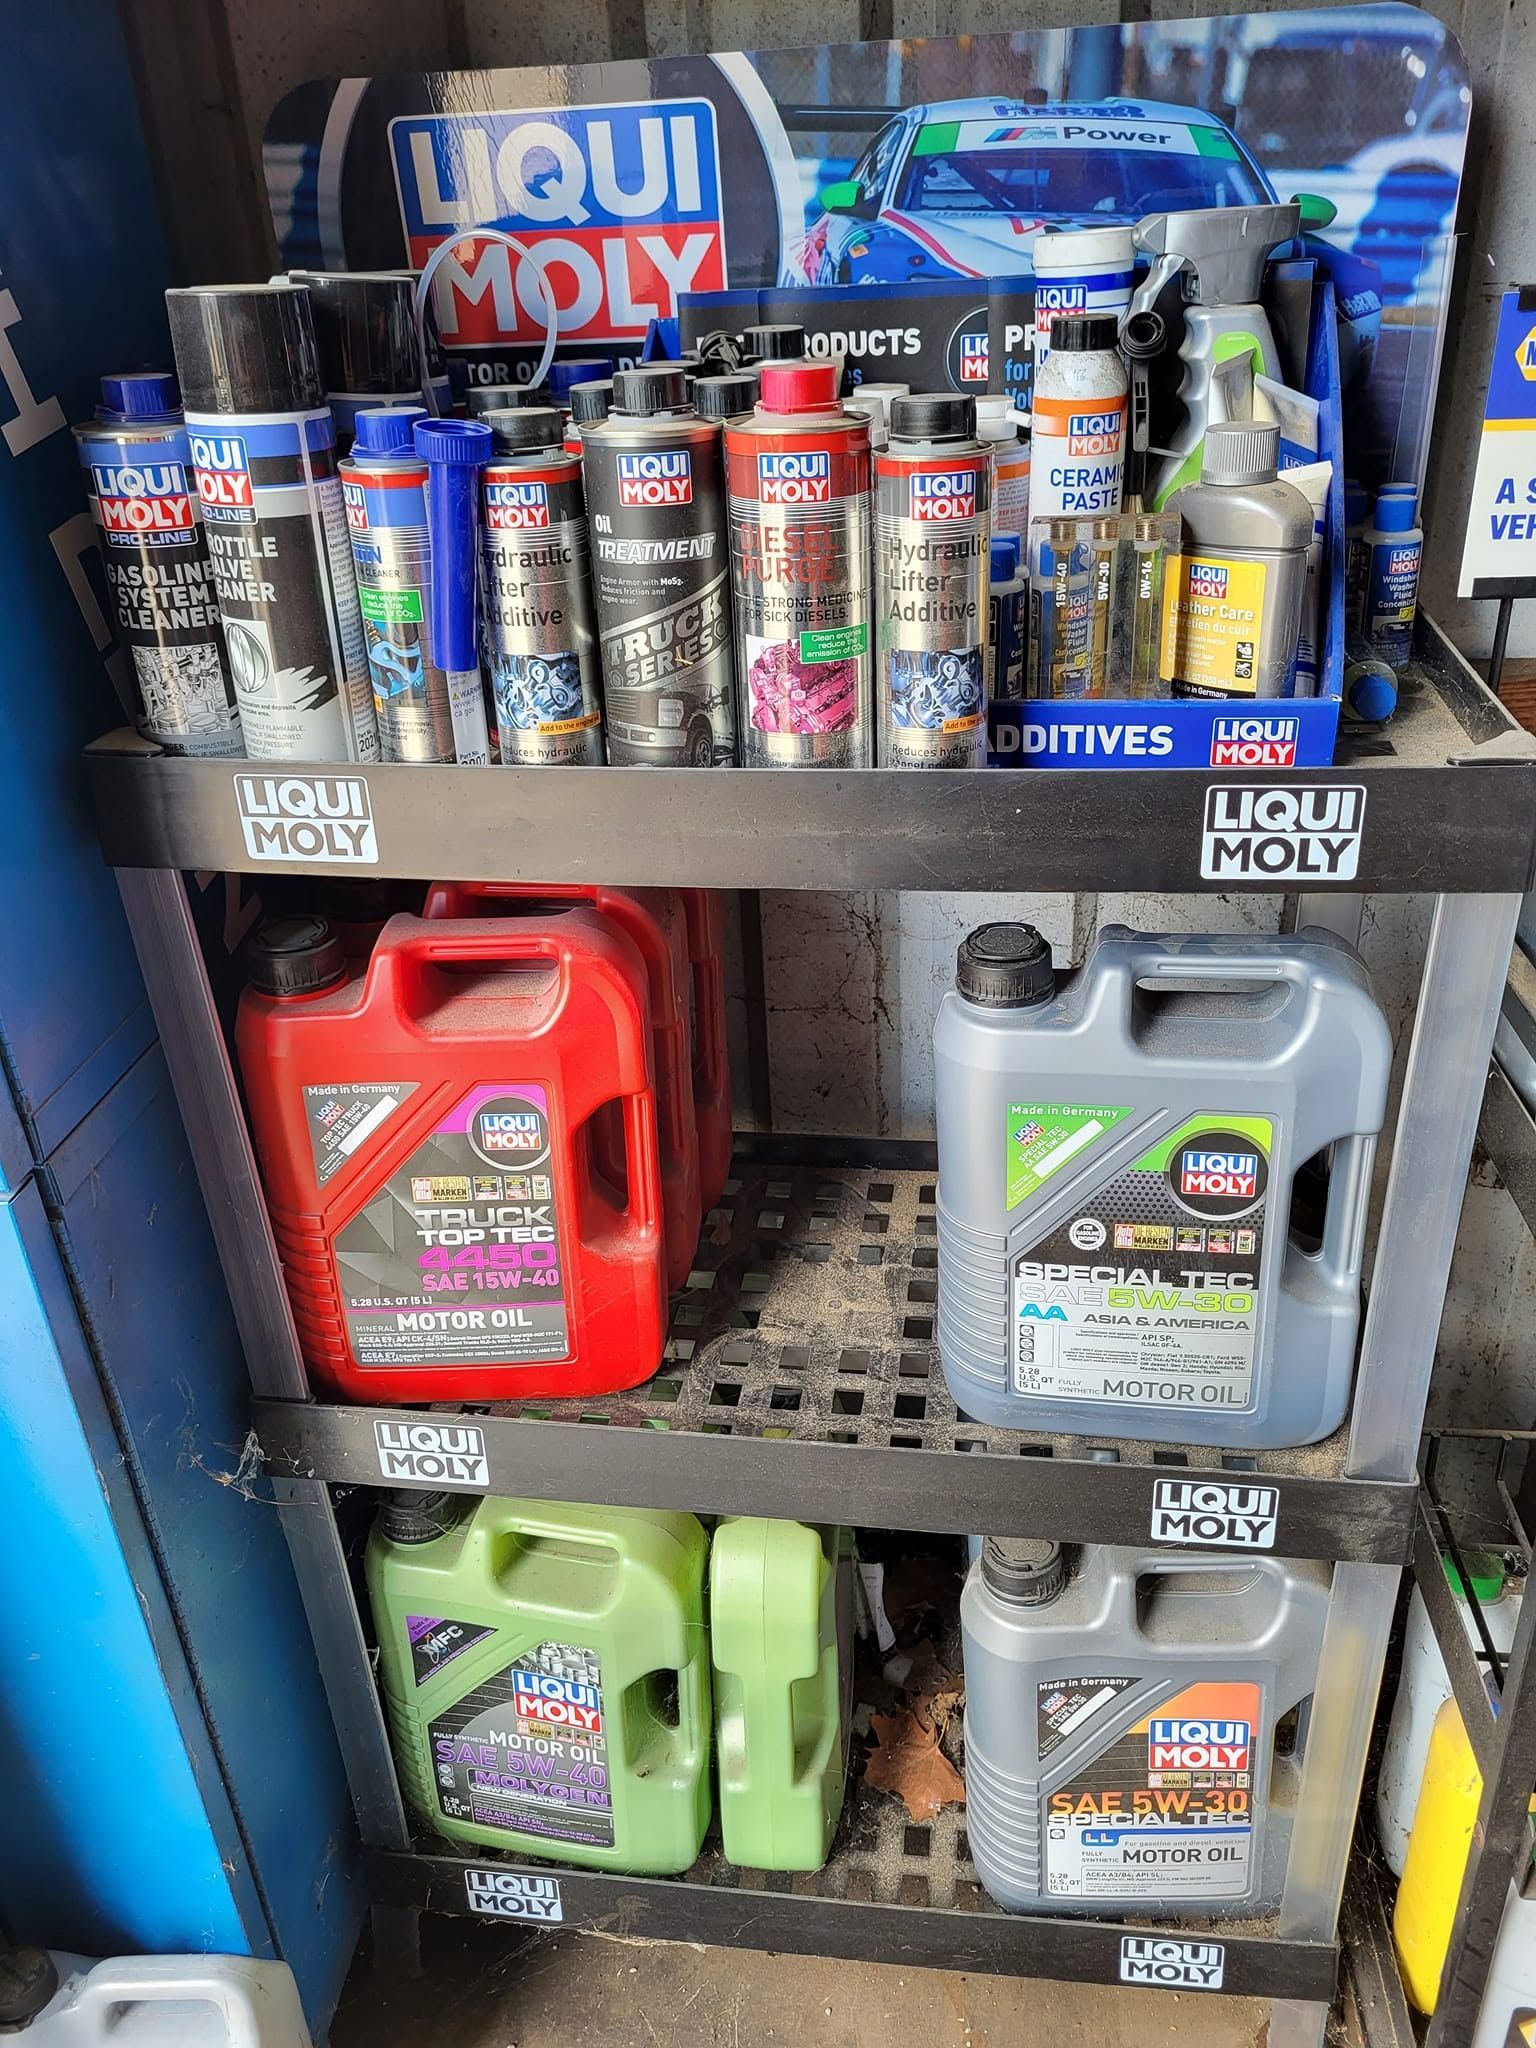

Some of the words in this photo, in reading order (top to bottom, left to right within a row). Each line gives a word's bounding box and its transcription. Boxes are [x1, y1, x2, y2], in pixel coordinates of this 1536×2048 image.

[1063, 127, 1171, 144] Power
[408, 114, 701, 227] LIQUI
[427, 232, 714, 335] MOLY
[1037, 287, 1084, 310] LIQUI
[1004, 358, 1032, 382] for
[1071, 414, 1120, 436] LIQUI
[1070, 436, 1119, 456] MOLY
[620, 454, 688, 480] LIQUI
[761, 455, 827, 479] LIQUI
[94, 467, 182, 498] LIQUI
[198, 473, 248, 504] OLY
[621, 479, 690, 504] MOLY
[762, 478, 828, 503] MOLY
[913, 474, 973, 496] LIQUI
[1495, 478, 1515, 504] A
[486, 486, 543, 507] LIQUI
[914, 496, 974, 519] MOLY
[1062, 488, 1119, 511] PASTE
[102, 499, 195, 529] MOLY
[488, 507, 546, 528] MOLY
[595, 514, 612, 534] Oil
[109, 531, 193, 545] PRO-LINE
[597, 535, 715, 561] TREATMENT
[740, 523, 841, 554] DIESEL
[890, 534, 987, 567] Hydraulic
[107, 560, 213, 586] GASOLINE
[742, 554, 836, 584] PURGE
[1190, 565, 1226, 583] LIQUI
[1391, 559, 1419, 574] MOLY
[618, 577, 641, 586] Armor
[641, 577, 659, 586] with
[890, 568, 952, 592] Lifter
[1055, 562, 1068, 608] 15W-40
[1098, 561, 1110, 601] 5W-30
[1140, 560, 1153, 599] 0W-16
[1189, 581, 1227, 599] MOLY
[1389, 581, 1416, 593] Washer
[117, 587, 209, 609] SYSTEM
[763, 597, 812, 609] STRONG
[817, 587, 867, 607] MEDICINE
[1393, 590, 1412, 600] Fluid
[119, 607, 221, 631] CLEANER
[764, 610, 792, 622] SICK
[795, 607, 849, 623] DIESELS.
[890, 600, 977, 623] Additive
[1170, 600, 1217, 617] Leather
[1219, 604, 1254, 622] Care
[607, 588, 723, 667] TRUCK
[811, 634, 835, 642] Clean
[836, 627, 862, 641] engines
[1212, 622, 1226, 633] du
[1228, 624, 1251, 636] cuir
[626, 627, 713, 687] SERIES
[1215, 720, 1294, 743] LIQUI
[892, 743, 937, 758] Reduces
[939, 739, 984, 758] hydraulic
[1214, 743, 1294, 766] MOLY
[242, 779, 364, 818] LIQUI
[1213, 791, 1354, 833] LIQUI
[251, 821, 369, 857] MOLY
[1211, 837, 1355, 875] MOLY
[308, 1087, 338, 1096] Made
[339, 1085, 350, 1094] in
[351, 1084, 401, 1095] Germany
[484, 1115, 537, 1133] LIQUI
[1011, 1106, 1043, 1115] Made
[1048, 1106, 1058, 1115] in
[1062, 1106, 1118, 1119] Germany
[485, 1132, 539, 1149] MOLY
[1018, 1138, 1049, 1163] SPECIAL
[1046, 1125, 1062, 1140] TEC
[1020, 1126, 1044, 1147] MOLY
[1186, 1153, 1254, 1175] LIQUI
[433, 1189, 467, 1197] MARKEN
[1185, 1174, 1255, 1197] MOLY
[414, 1206, 553, 1229] TRUCK
[416, 1228, 486, 1246] TOP
[490, 1225, 555, 1244] TEC
[1135, 1237, 1169, 1246] MARKEN
[418, 1243, 557, 1272] 4450
[422, 1273, 469, 1292] SAE
[473, 1268, 560, 1290] 15W-40
[1019, 1262, 1174, 1288] SPECIAL
[1180, 1271, 1254, 1290] TEC
[351, 1298, 373, 1307] 5.28
[374, 1297, 394, 1306] U.S.
[410, 1296, 421, 1306] (5
[423, 1296, 432, 1305] L)
[1019, 1282, 1102, 1307] SAE
[1107, 1287, 1253, 1313] 5W-30
[355, 1325, 395, 1333] MINERAL
[396, 1310, 486, 1332] MOTOR
[491, 1308, 533, 1328] OIL
[1018, 1303, 1069, 1322] AA
[1083, 1313, 1132, 1327] ASIA
[1136, 1316, 1150, 1327] &
[1154, 1316, 1250, 1331] AMERICA
[1019, 1366, 1041, 1376] 5.28
[1057, 1386, 1100, 1395] SYNTHETIC
[1058, 1379, 1082, 1387] FULLY
[1103, 1379, 1195, 1402] MOTOR
[1200, 1385, 1243, 1405] OIL
[381, 1424, 479, 1455] LIQUI
[388, 1452, 483, 1481] MOLY
[1160, 1483, 1273, 1517] LIQUI
[1158, 1511, 1274, 1544] MOLY
[517, 1673, 594, 1708] LIQUI
[1039, 1682, 1066, 1691] Made
[1081, 1679, 1129, 1687] Germany
[519, 1695, 598, 1730] MOLY
[1155, 1722, 1245, 1745] LIQUI
[454, 1734, 489, 1744] SYNTHETIC
[489, 1730, 564, 1758] MOTOR
[570, 1745, 605, 1766] OIL
[1154, 1747, 1248, 1768] MOLY
[436, 1740, 499, 1769] SAE
[507, 1750, 606, 1788] 5W-40
[475, 1770, 609, 1807] MOLYGEN
[476, 1784, 502, 1795] NEW
[501, 1788, 568, 1807] GENERATION
[1051, 1792, 1123, 1815] SAE
[1133, 1791, 1248, 1814] 5W-30
[1047, 1812, 1181, 1827] SPECIAL
[1187, 1811, 1250, 1825] TEC
[1085, 1832, 1114, 1843] LL
[1123, 1848, 1202, 1864] MOTOR
[1207, 1847, 1243, 1862] OIL
[470, 1873, 553, 1898] LIQUI
[476, 1894, 556, 1918] MOLY
[1128, 1941, 1218, 1966] LIQUI
[1128, 1962, 1220, 1985] MOLY
